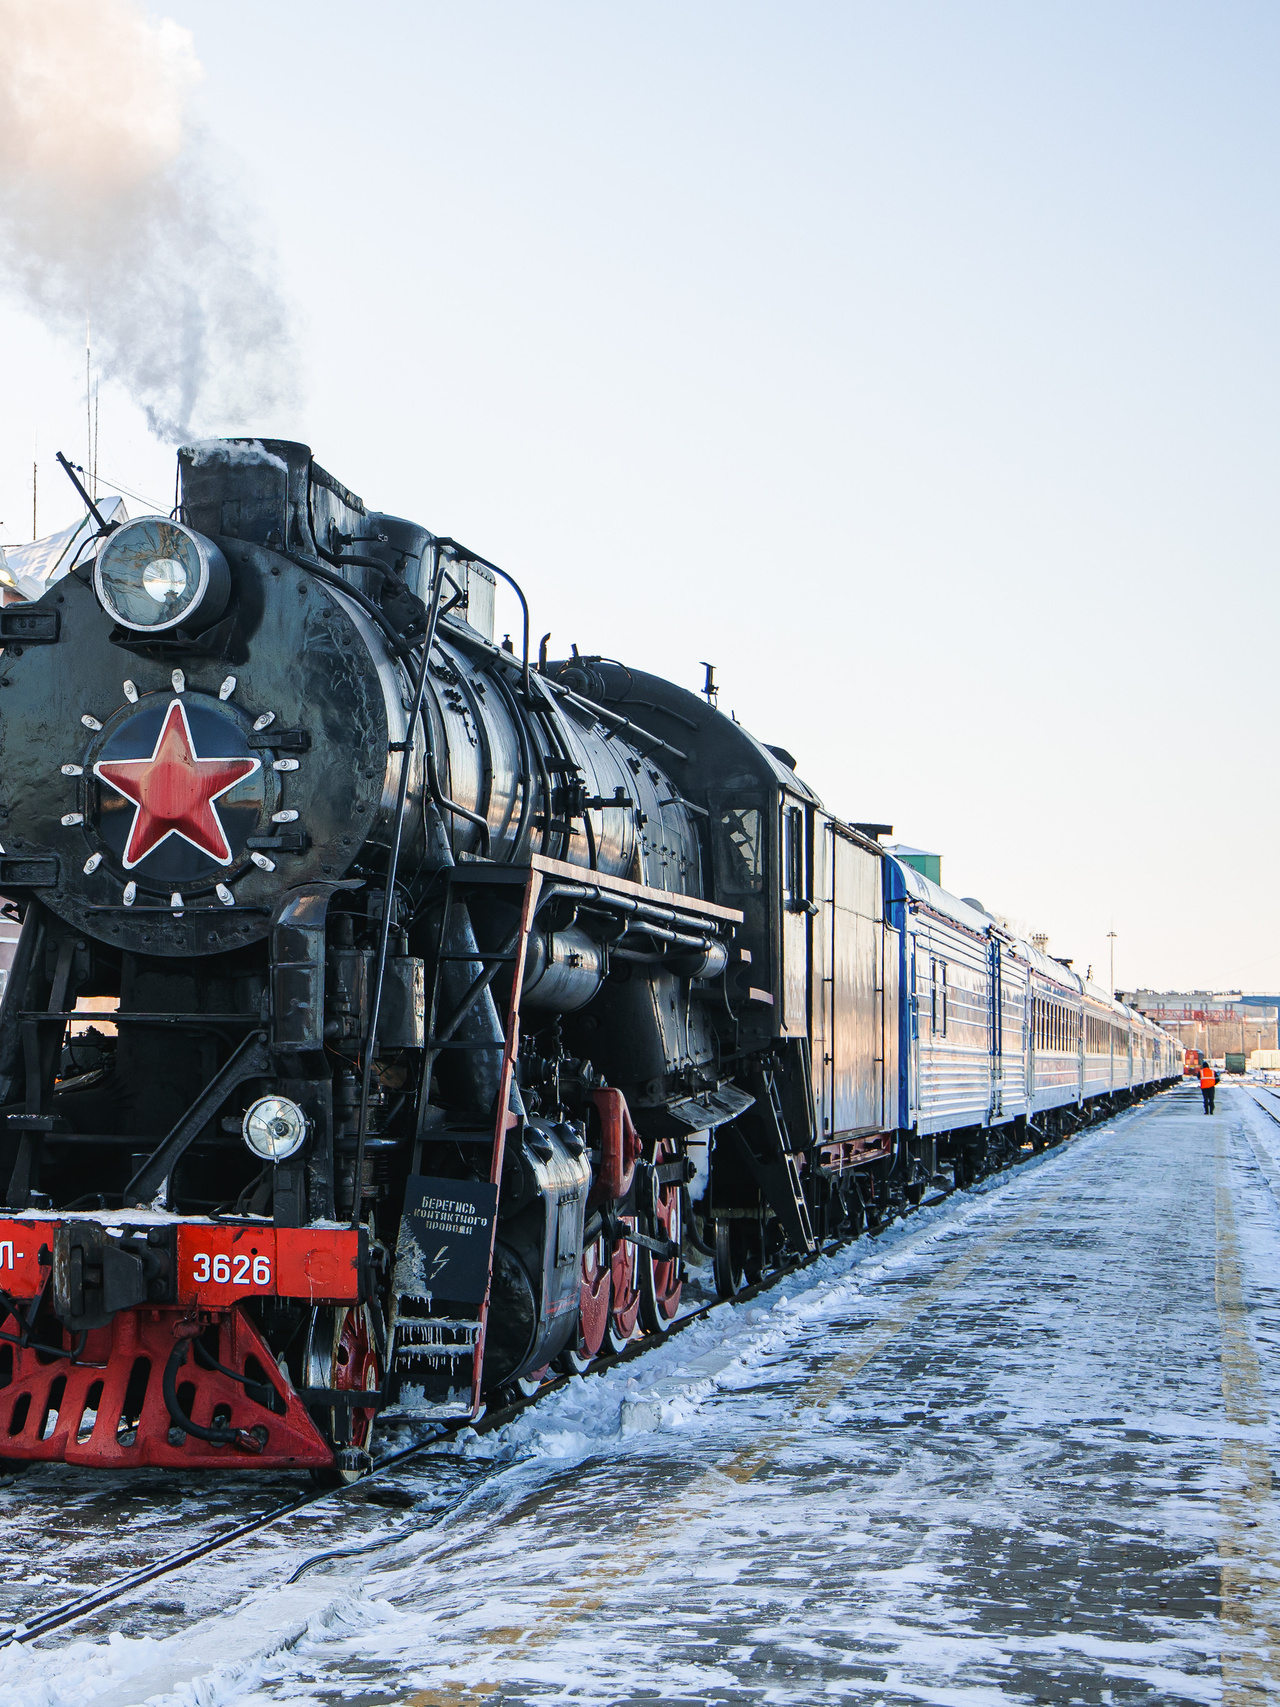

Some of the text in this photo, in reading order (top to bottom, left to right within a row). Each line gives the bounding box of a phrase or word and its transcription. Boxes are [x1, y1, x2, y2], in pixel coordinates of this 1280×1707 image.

[421, 1195, 477, 1215] БЕРЕГИСЬ
[413, 1208, 489, 1228] КОНТАКТНОГО
[425, 1220, 474, 1236] ПРОВОДА
[192, 1252, 272, 1286] 3626
